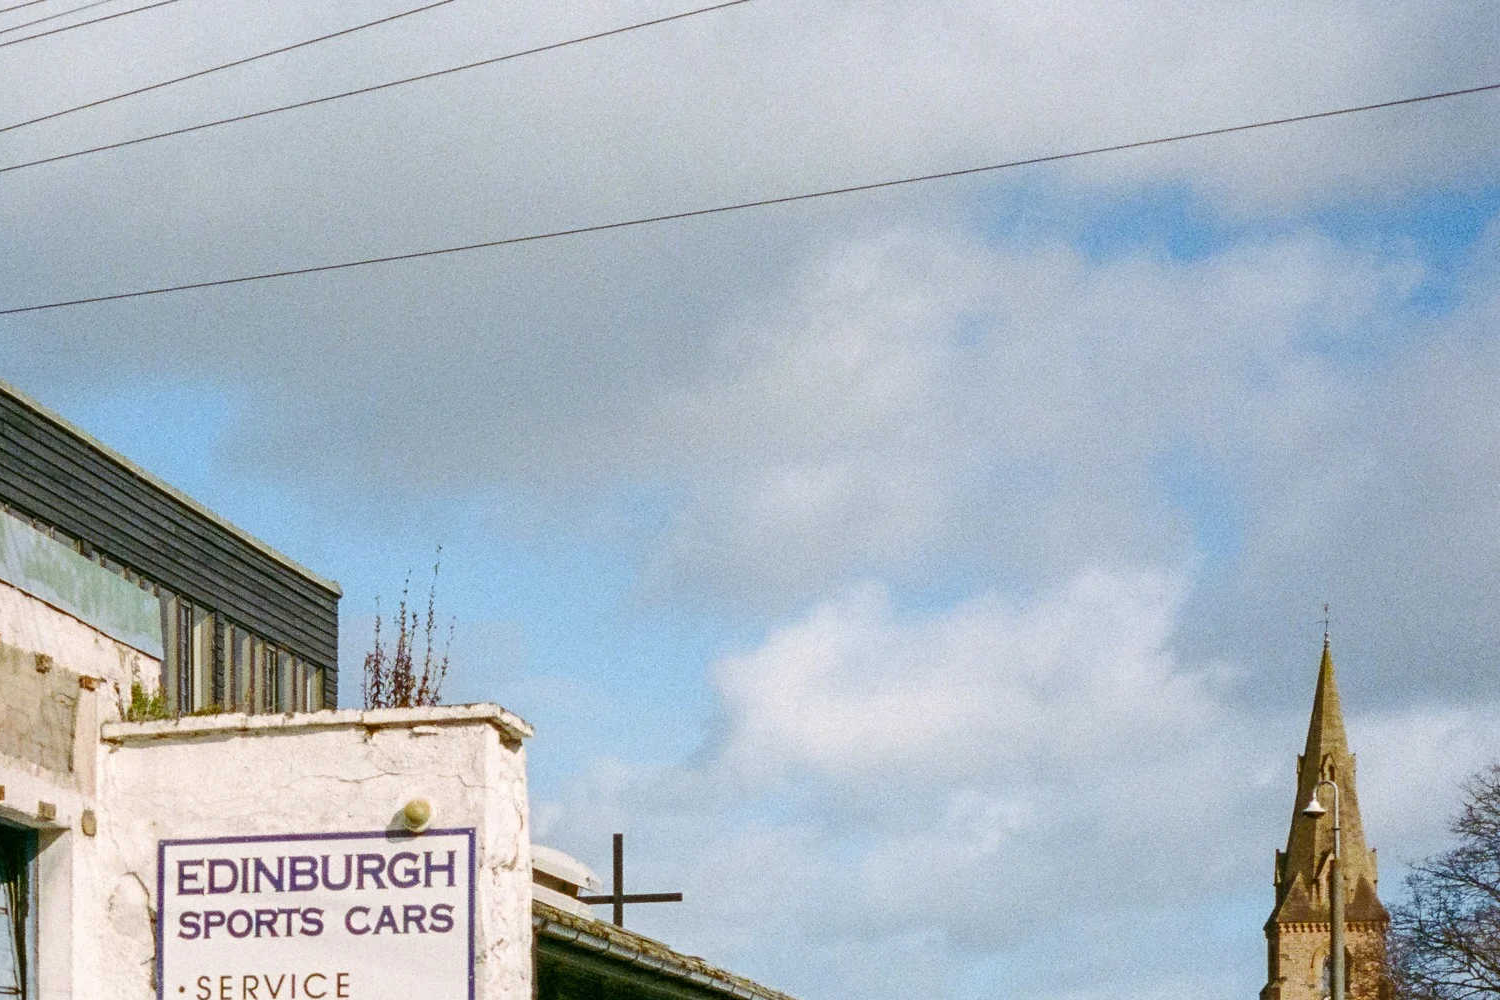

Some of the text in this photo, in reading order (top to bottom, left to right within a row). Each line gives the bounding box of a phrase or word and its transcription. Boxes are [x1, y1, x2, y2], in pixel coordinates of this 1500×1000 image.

[176, 850, 457, 896] EDINBURGH
[177, 903, 455, 939] SPORTS CARS
[196, 972, 352, 1000] SERVICE
